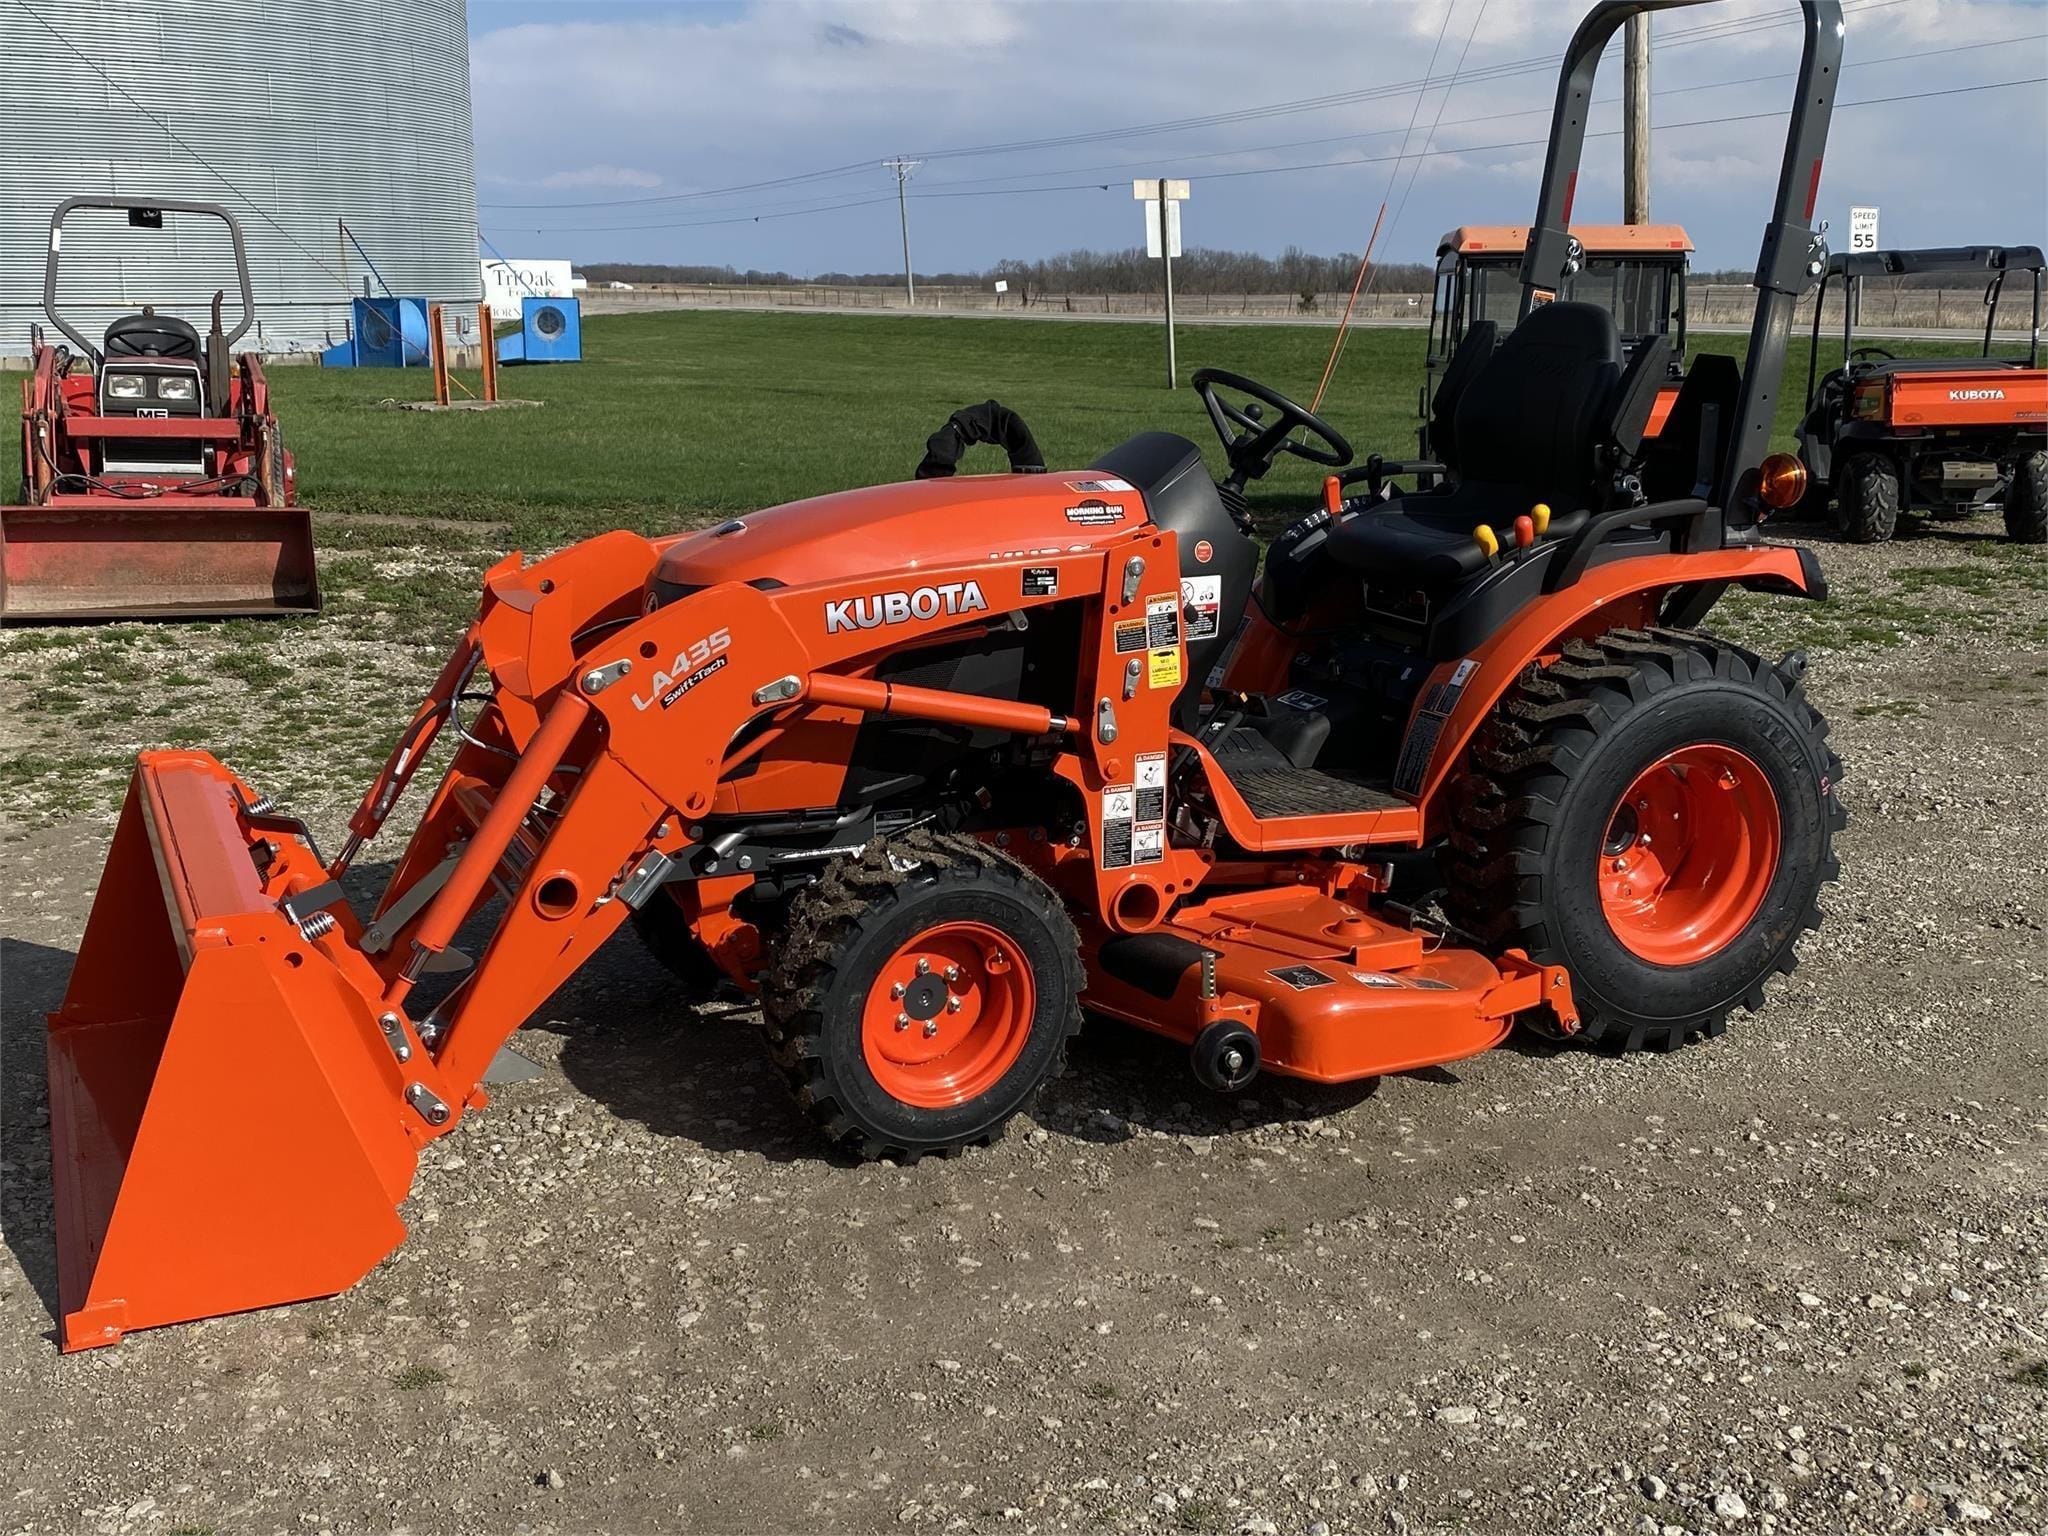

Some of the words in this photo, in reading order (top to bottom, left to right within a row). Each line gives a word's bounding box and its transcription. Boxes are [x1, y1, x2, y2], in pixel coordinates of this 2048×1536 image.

[1853, 212, 1876, 220] SPEED
[1854, 234, 1874, 248] 55
[493, 269, 554, 287] TriOak
[508, 286, 543, 297] Foods
[1949, 390, 2005, 401] KUBOTA
[1066, 506, 1104, 516] MORNING
[1105, 505, 1123, 514] SUN
[825, 580, 988, 635] KUBOTA
[631, 626, 732, 712] LA435
[663, 658, 726, 707] Swift-Tach
[1142, 754, 1164, 762] DANGER
[1110, 785, 1132, 793] DANGER
[1140, 823, 1162, 832] DANGER
